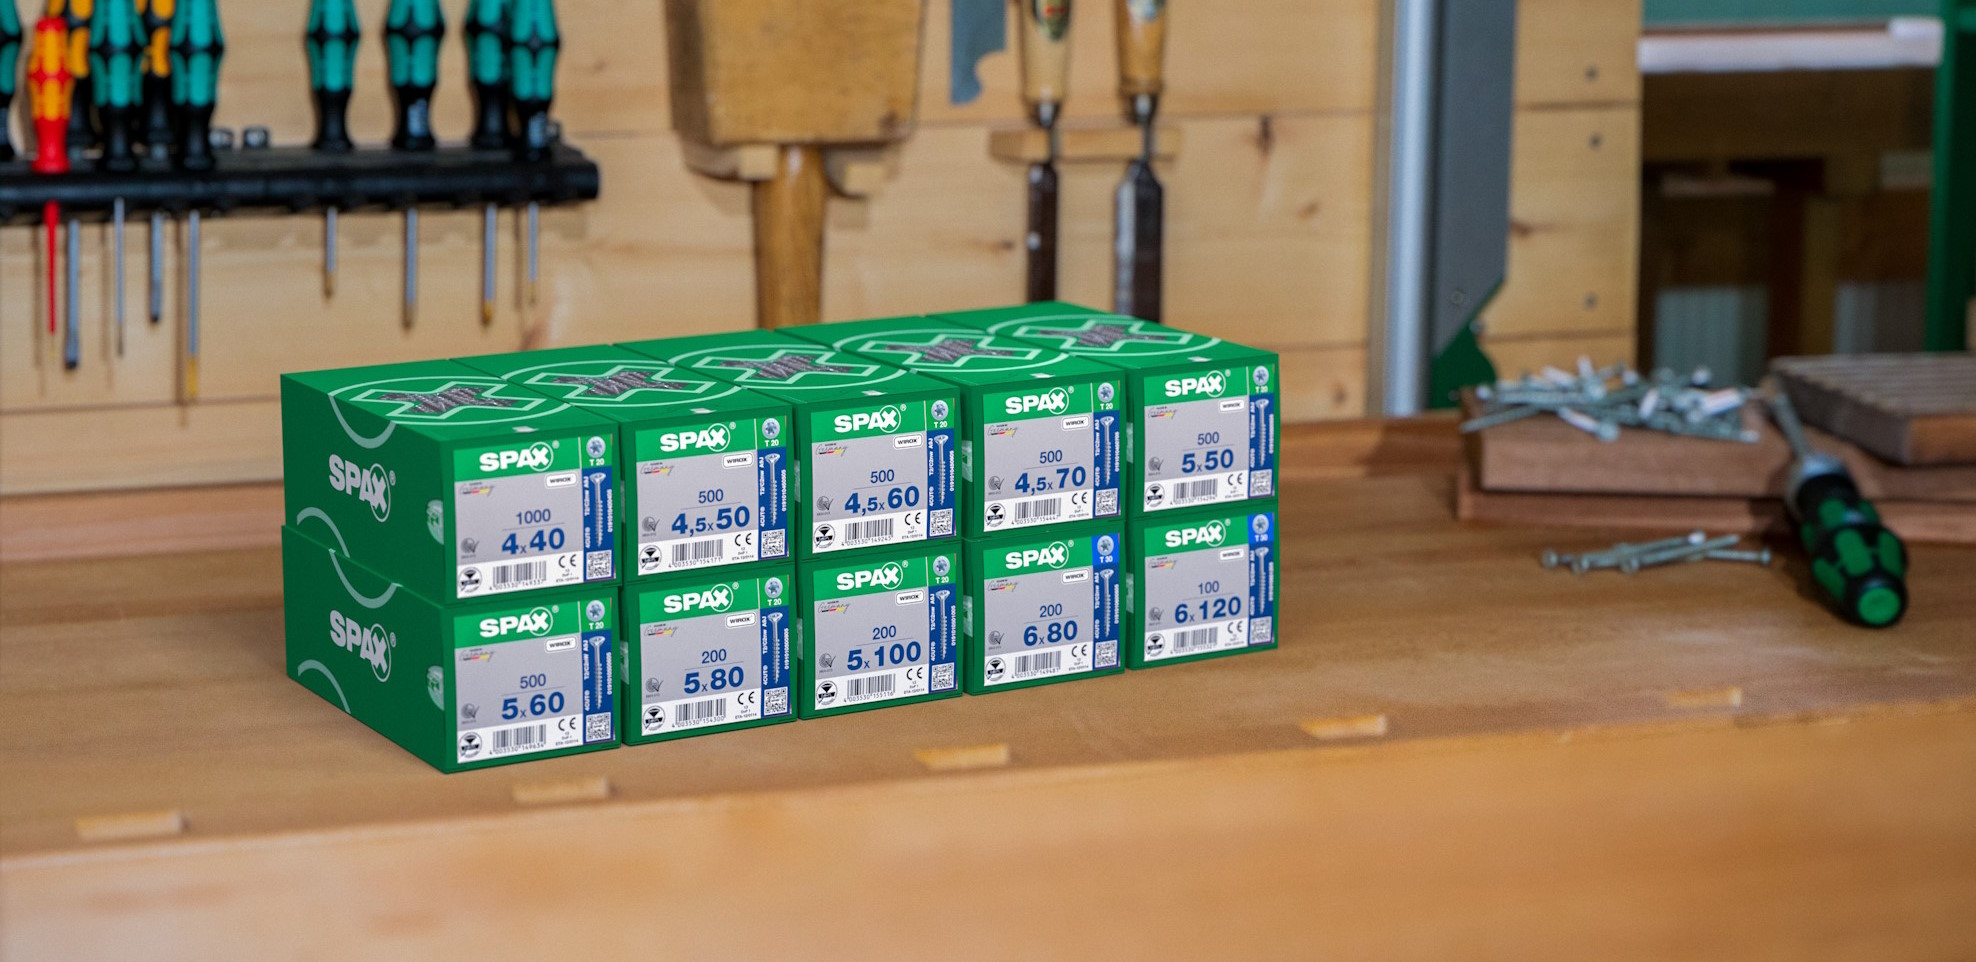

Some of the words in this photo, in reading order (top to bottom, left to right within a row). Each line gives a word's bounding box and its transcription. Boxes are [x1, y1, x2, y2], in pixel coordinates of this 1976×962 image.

[1197, 431, 1220, 445] 500
[1039, 449, 1063, 464] 500
[870, 469, 895, 484] 500
[698, 488, 724, 504] 500
[516, 508, 551, 525] 1000
[1198, 580, 1220, 594] 100
[1039, 603, 1063, 618] 200
[872, 625, 897, 640] 200
[701, 648, 727, 664] 200
[520, 673, 546, 689] 500
